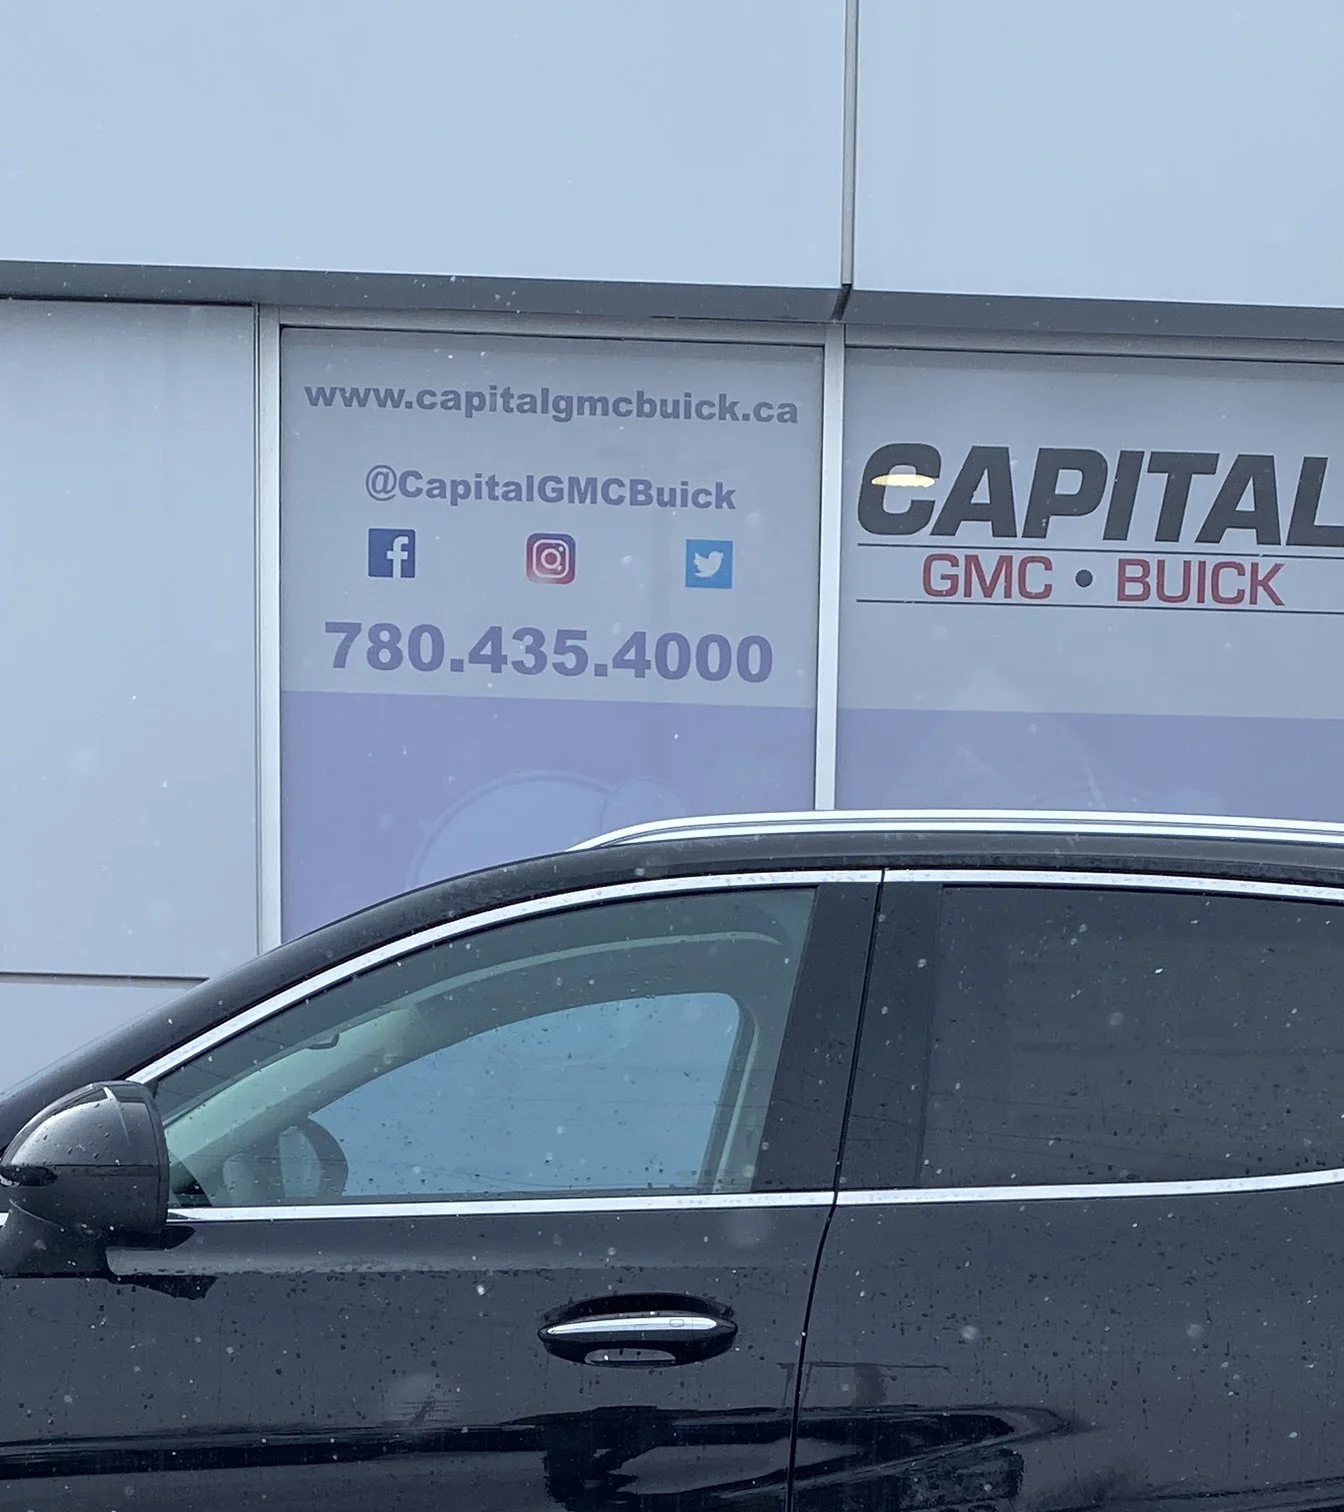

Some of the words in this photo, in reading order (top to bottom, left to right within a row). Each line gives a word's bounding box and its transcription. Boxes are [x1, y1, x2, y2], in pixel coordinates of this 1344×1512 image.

[304, 384, 798, 424] www.capitalgmcbuick.ca
[365, 464, 737, 511] @CapitalGMCBuick
[921, 552, 1053, 600] GMC
[1115, 557, 1286, 607] BUICK
[324, 620, 774, 684] 780.435.4000
